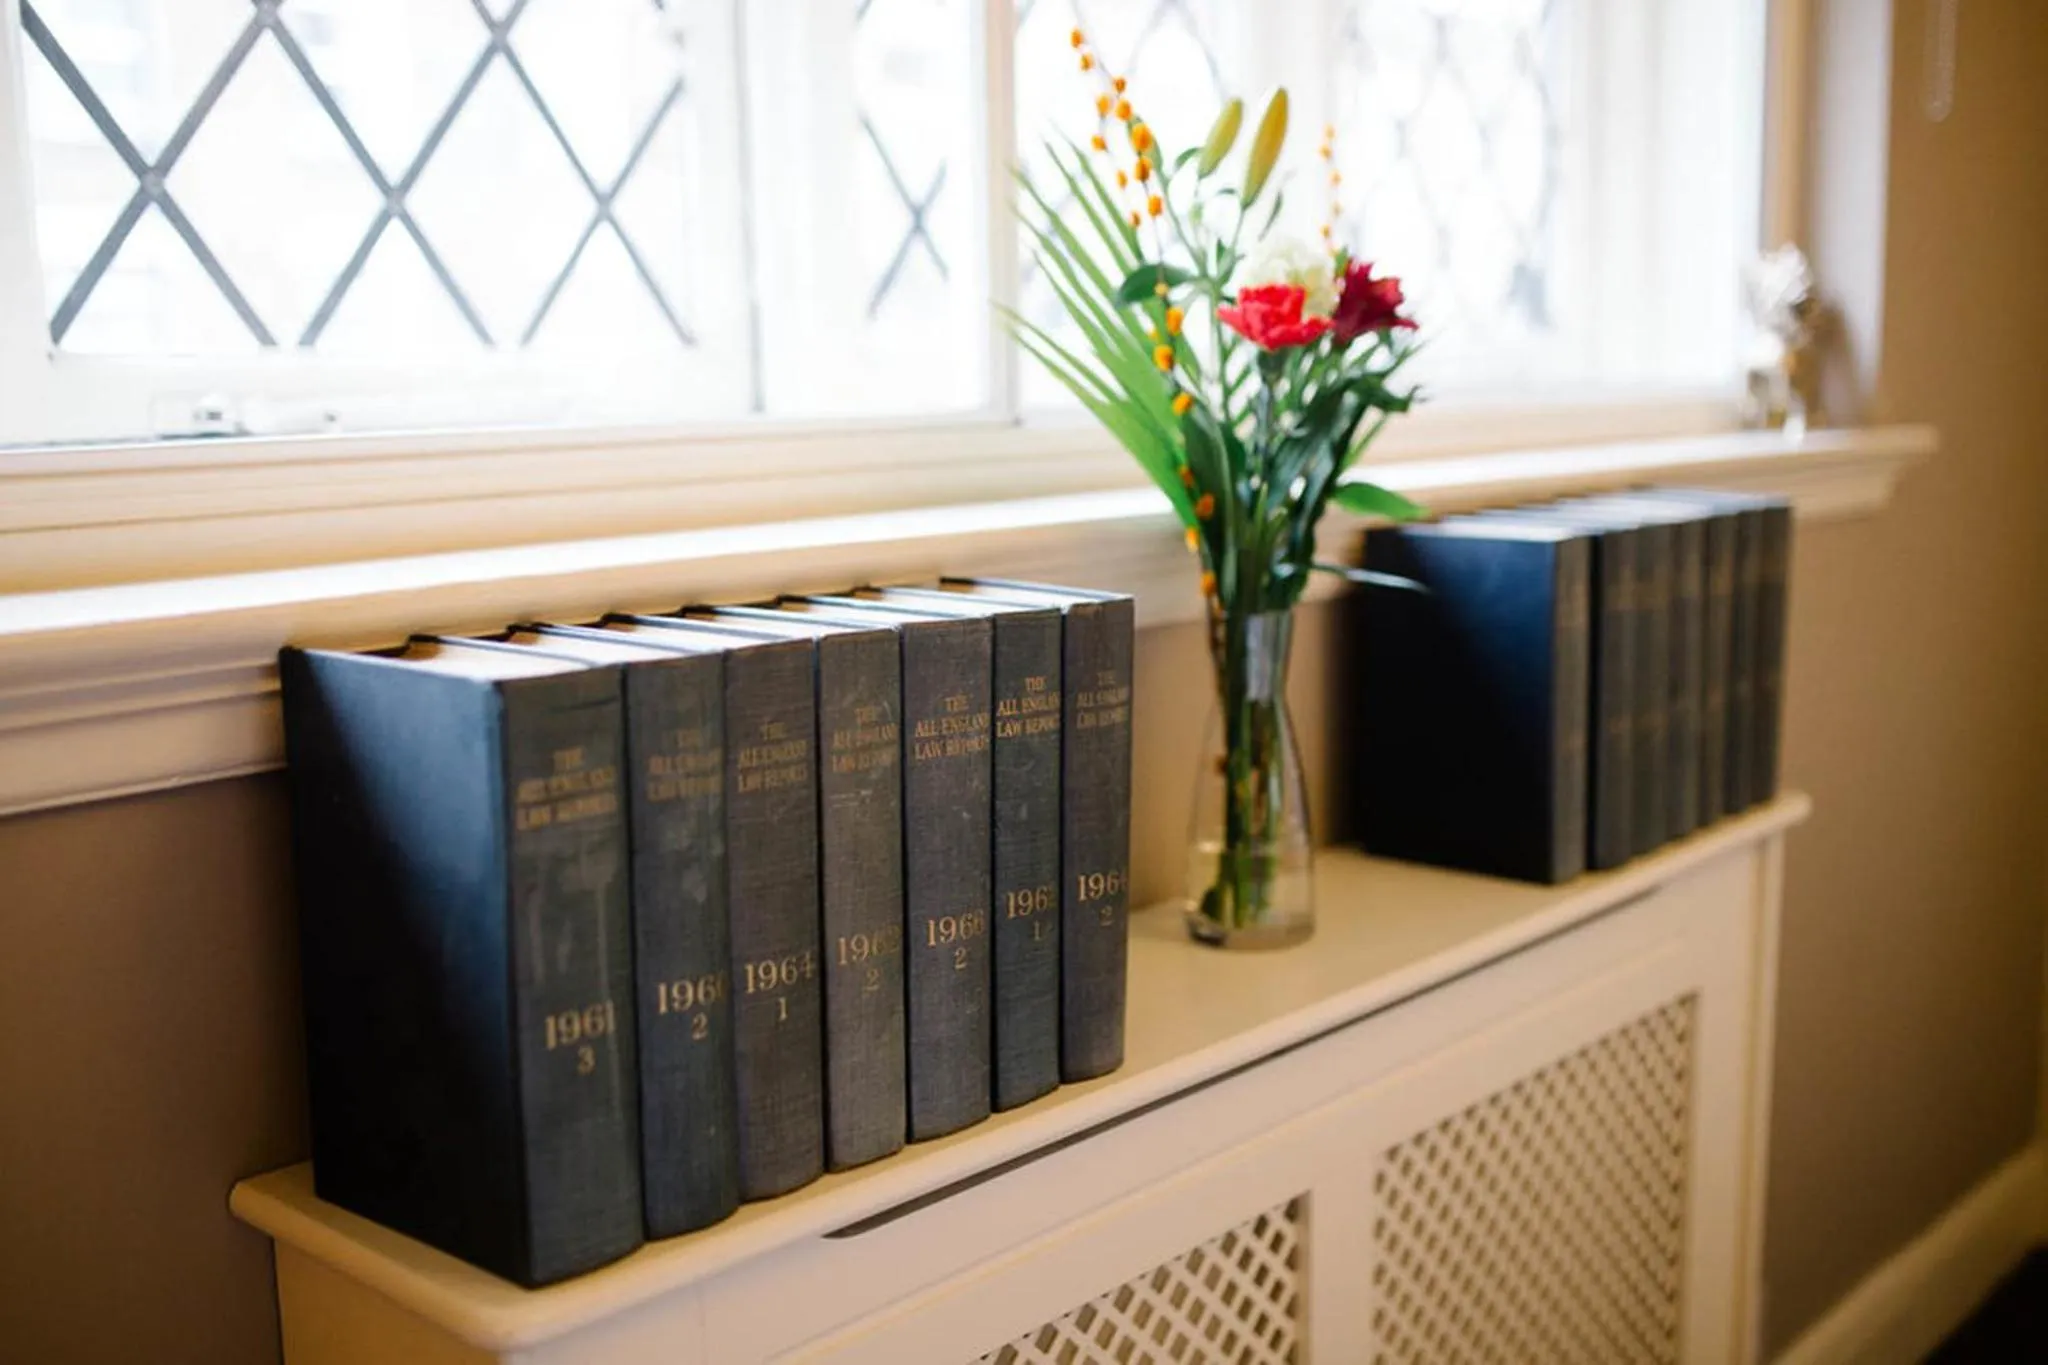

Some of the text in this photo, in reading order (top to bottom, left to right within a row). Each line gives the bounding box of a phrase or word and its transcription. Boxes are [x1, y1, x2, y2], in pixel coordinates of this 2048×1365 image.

[996, 699, 1018, 717] ALL
[915, 718, 938, 739] ALL
[996, 722, 1021, 738] LAW
[915, 741, 943, 762] LAW
[1006, 887, 1056, 919] 196
[927, 909, 985, 947] 1966
[1100, 905, 1114, 928] 2
[1031, 920, 1042, 942] 1
[954, 946, 969, 971] 2
[863, 968, 881, 993] 2
[776, 997, 788, 1022] 1
[691, 1012, 708, 1041] 2
[577, 1045, 596, 1076] 3
